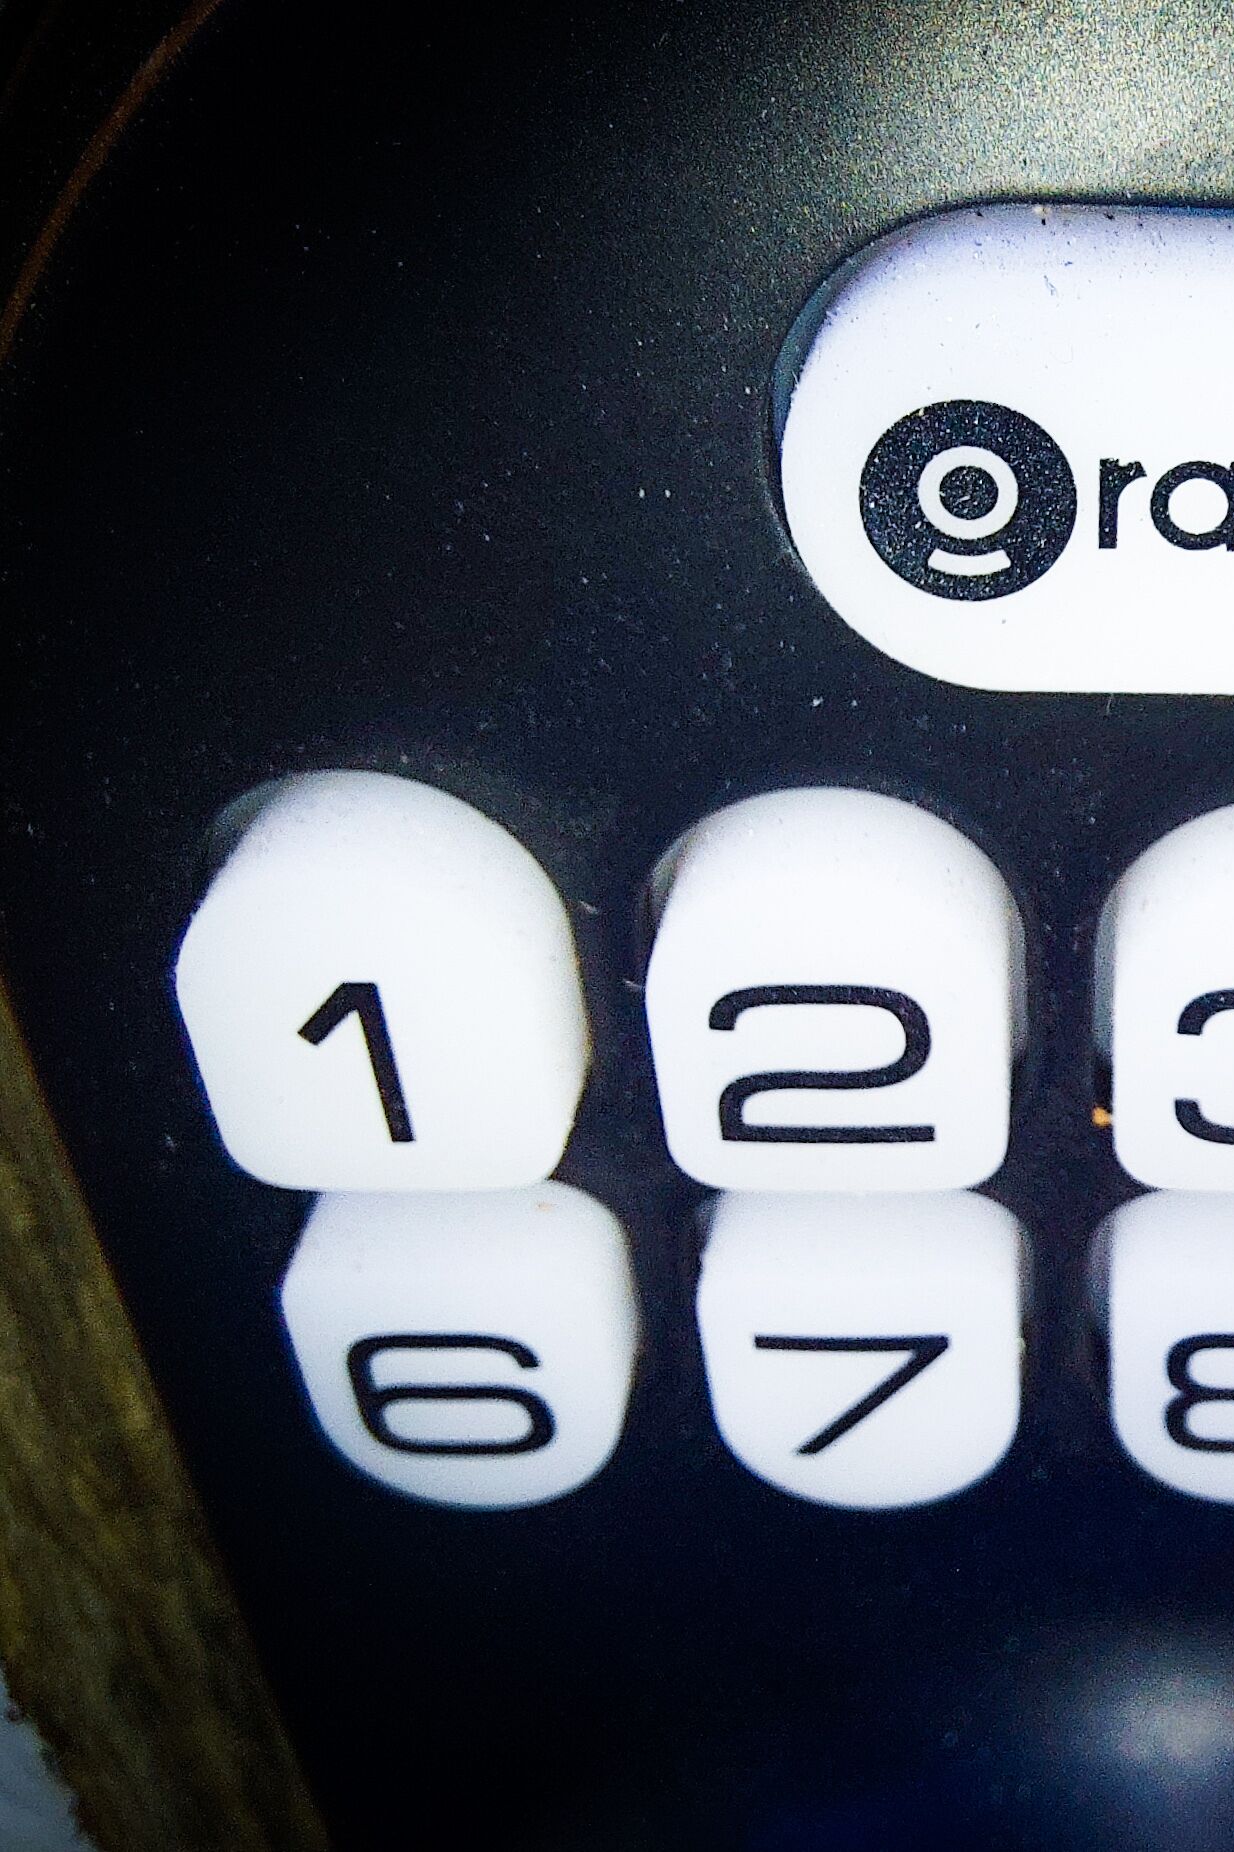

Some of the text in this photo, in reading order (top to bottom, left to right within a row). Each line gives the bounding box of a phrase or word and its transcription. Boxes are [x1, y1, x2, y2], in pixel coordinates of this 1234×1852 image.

[298, 983, 414, 1143] 1
[708, 984, 936, 1145] 2
[345, 1333, 558, 1459] 6
[754, 1334, 950, 1456] 7
